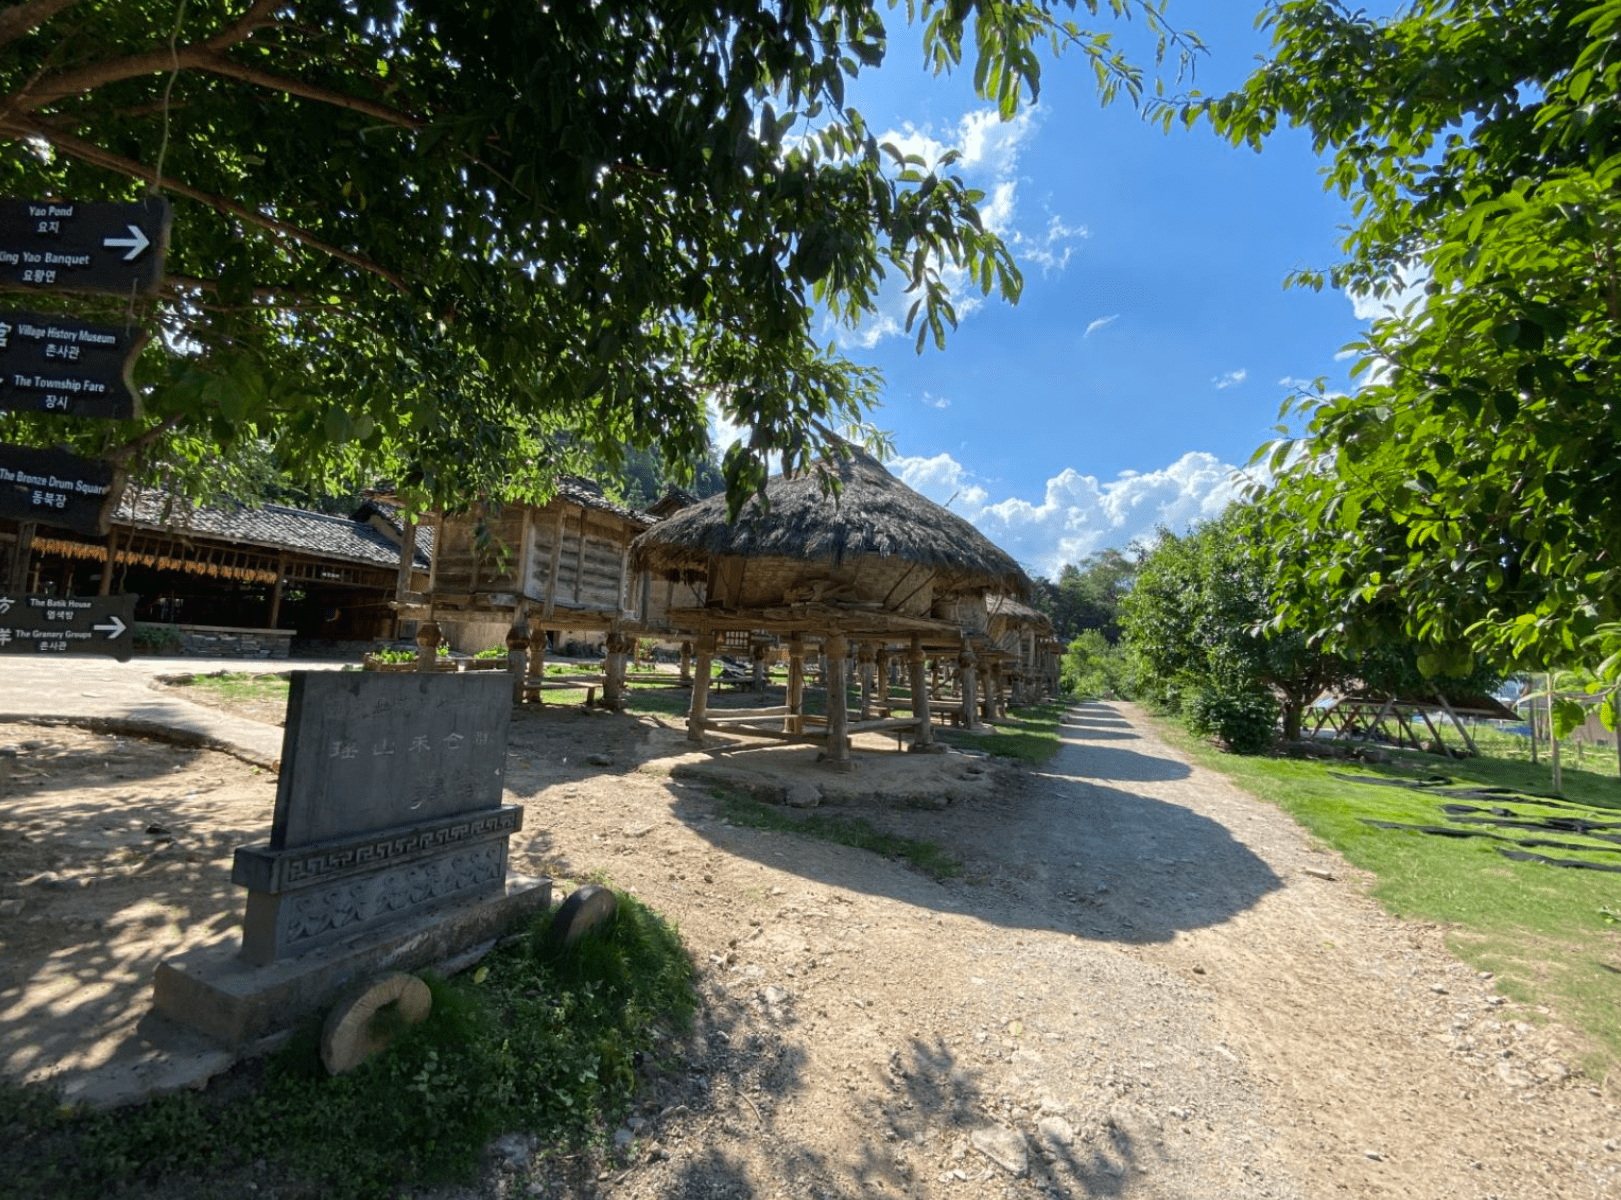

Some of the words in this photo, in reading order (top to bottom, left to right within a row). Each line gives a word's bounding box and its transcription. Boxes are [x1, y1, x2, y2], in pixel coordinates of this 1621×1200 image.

[29, 205, 46, 217] Yao
[48, 206, 73, 217] Pond
[37, 220, 60, 234] 요지
[22, 251, 42, 262] Yao
[45, 253, 90, 267] Banquet
[18, 324, 46, 339] Village
[47, 327, 78, 342] History
[79, 330, 116, 344] Museum
[14, 374, 32, 387] The
[34, 376, 82, 392] Township
[83, 379, 106, 392] Fare
[45, 394, 68, 410] 장시
[0, 468, 15, 481] The
[16, 471, 47, 486] Bronze
[48, 475, 74, 490] Drum
[30, 598, 45, 607] The
[68, 600, 92, 609] House
[15, 629, 31, 638] The
[32, 630, 64, 639] Granary
[65, 630, 92, 639] Groups
